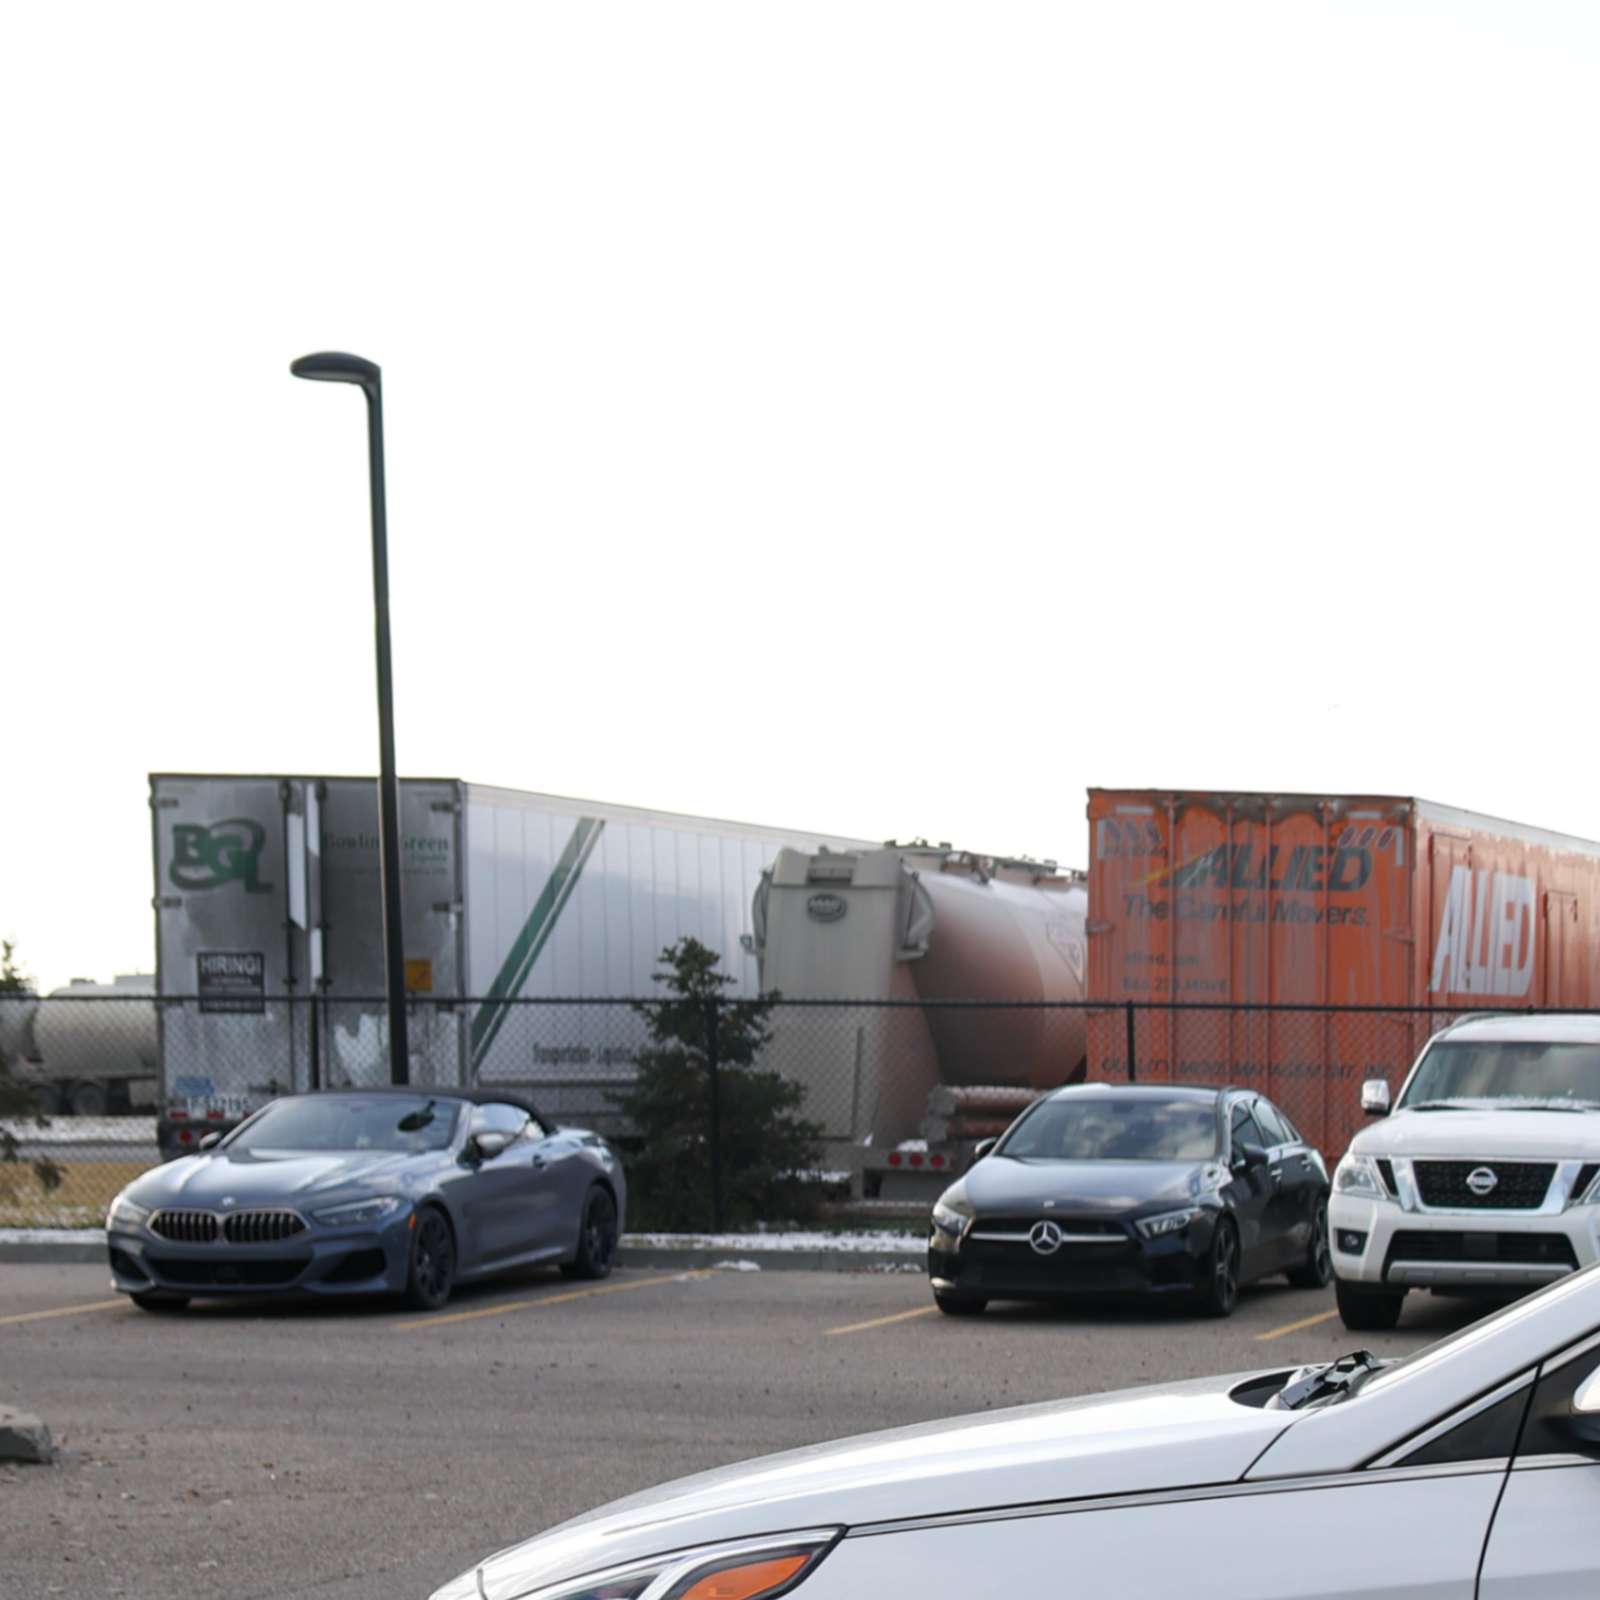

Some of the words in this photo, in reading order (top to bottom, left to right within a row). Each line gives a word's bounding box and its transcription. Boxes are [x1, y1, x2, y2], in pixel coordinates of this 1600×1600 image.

[1160, 842, 1372, 892] ALLIED
[1124, 893, 1170, 921] The
[1427, 864, 1536, 997] ALLIED
